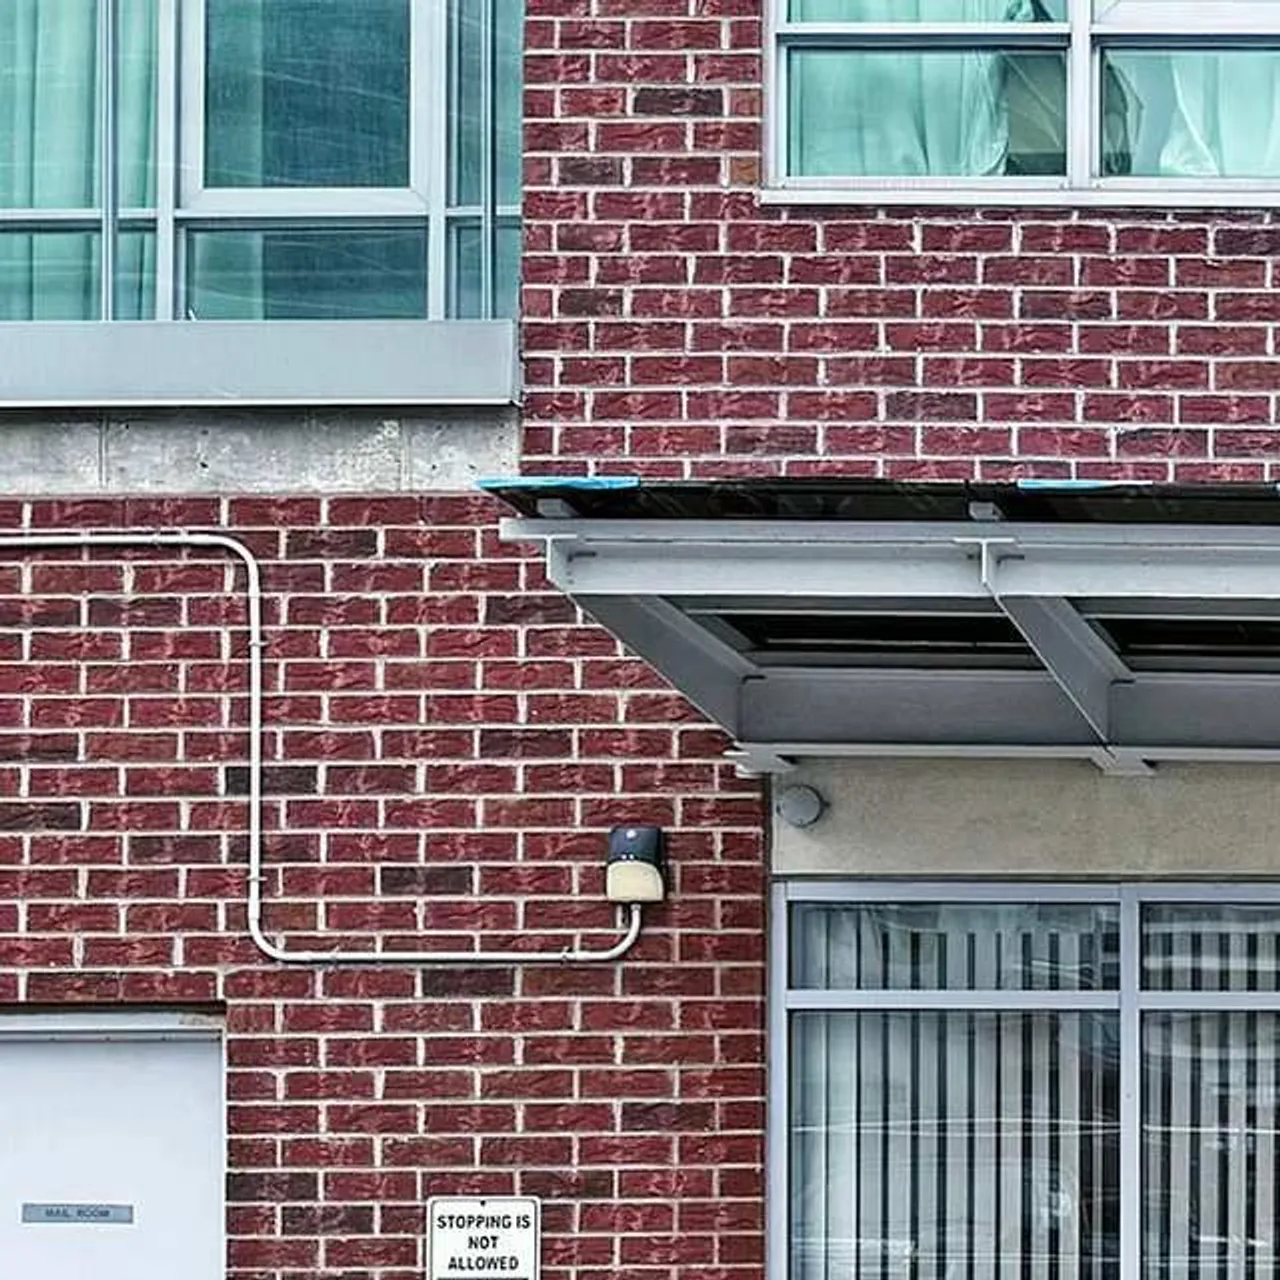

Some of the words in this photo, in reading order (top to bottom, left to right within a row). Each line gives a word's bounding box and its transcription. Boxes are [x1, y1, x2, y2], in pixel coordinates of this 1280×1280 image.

[437, 1215, 512, 1229] STOPPING
[516, 1215, 531, 1229] IS
[468, 1236, 499, 1249] NOT
[448, 1256, 519, 1270] ALLOWED
